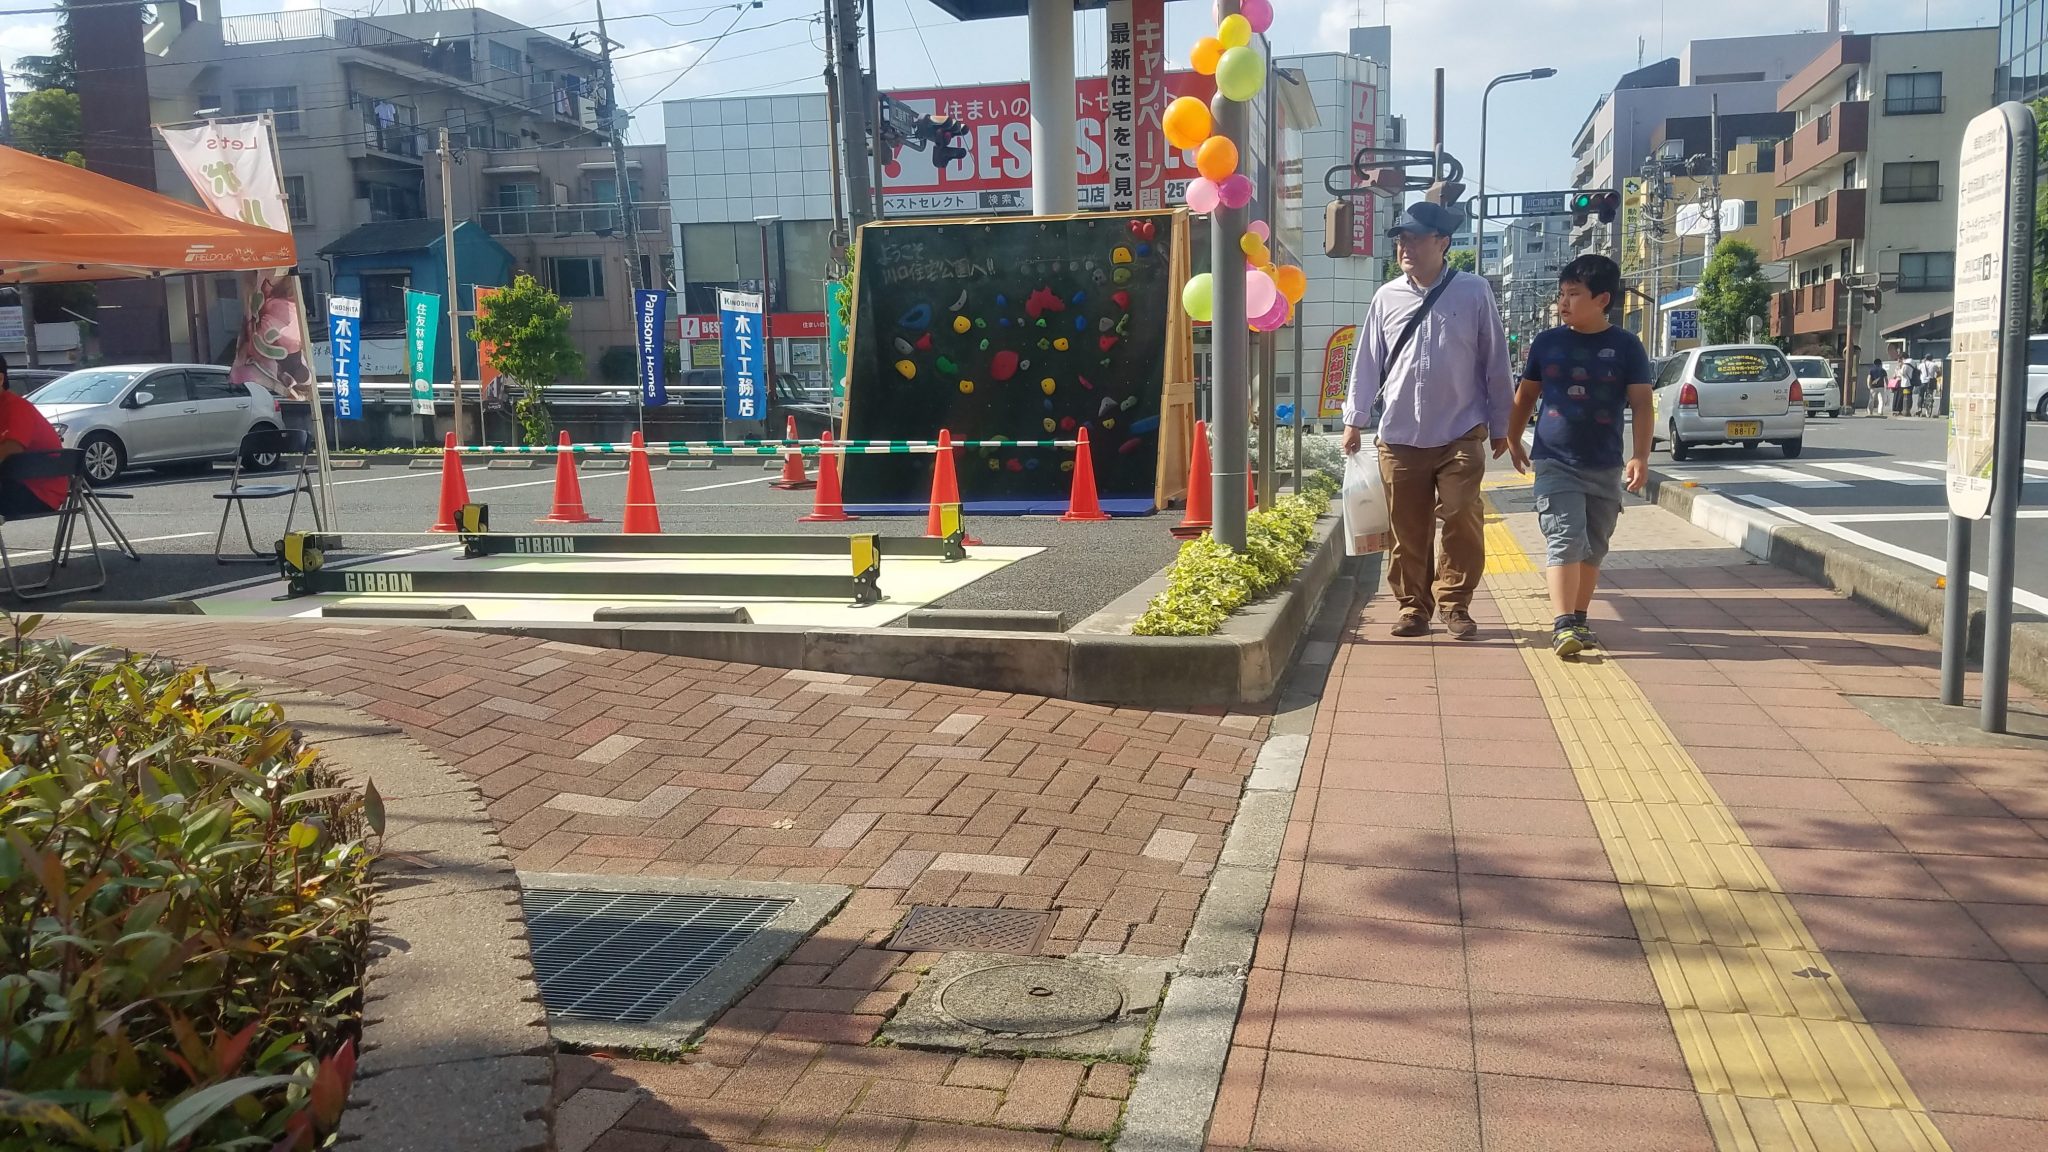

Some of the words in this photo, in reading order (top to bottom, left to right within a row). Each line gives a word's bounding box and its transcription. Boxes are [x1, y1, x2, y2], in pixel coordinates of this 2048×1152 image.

[946, 122, 1031, 181] BES
[2012, 136, 2032, 217] Kawaguchi
[884, 195, 964, 209] ベストセレクト
[2011, 223, 2029, 247] City
[644, 293, 658, 353] Panasonic
[2009, 254, 2027, 336] Information
[335, 318, 353, 416] 木下工務店
[643, 355, 658, 398] Homes
[734, 315, 755, 417] 木下工務店
[515, 537, 575, 553] GIBBON
[345, 572, 413, 592] GIBBON
